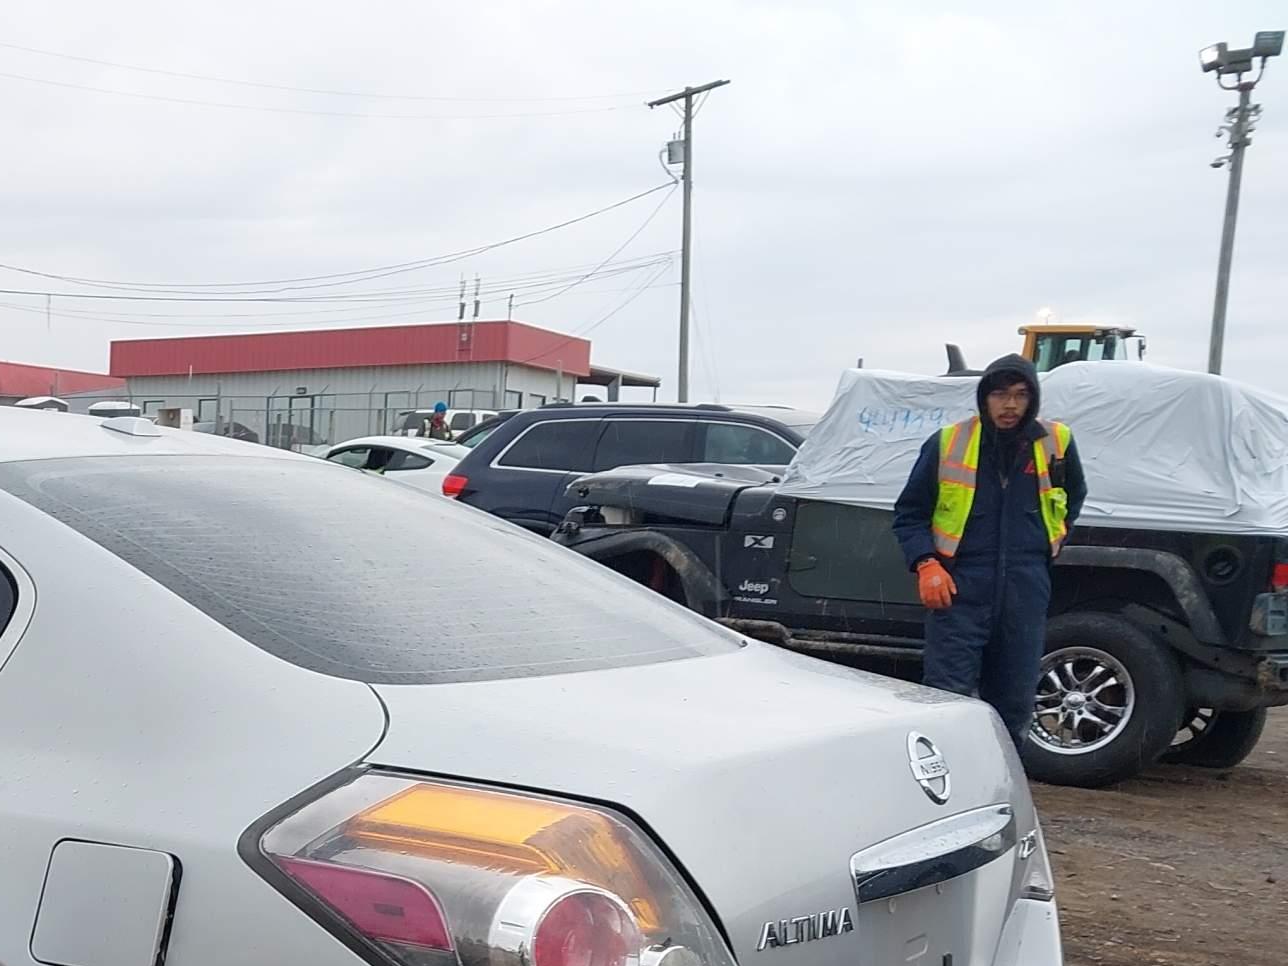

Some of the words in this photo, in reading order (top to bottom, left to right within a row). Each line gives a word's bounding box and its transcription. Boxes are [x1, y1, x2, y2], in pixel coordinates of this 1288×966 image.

[738, 579, 769, 595] Jeep
[732, 595, 778, 605] RANGLER
[756, 906, 854, 952] ALTIMA
